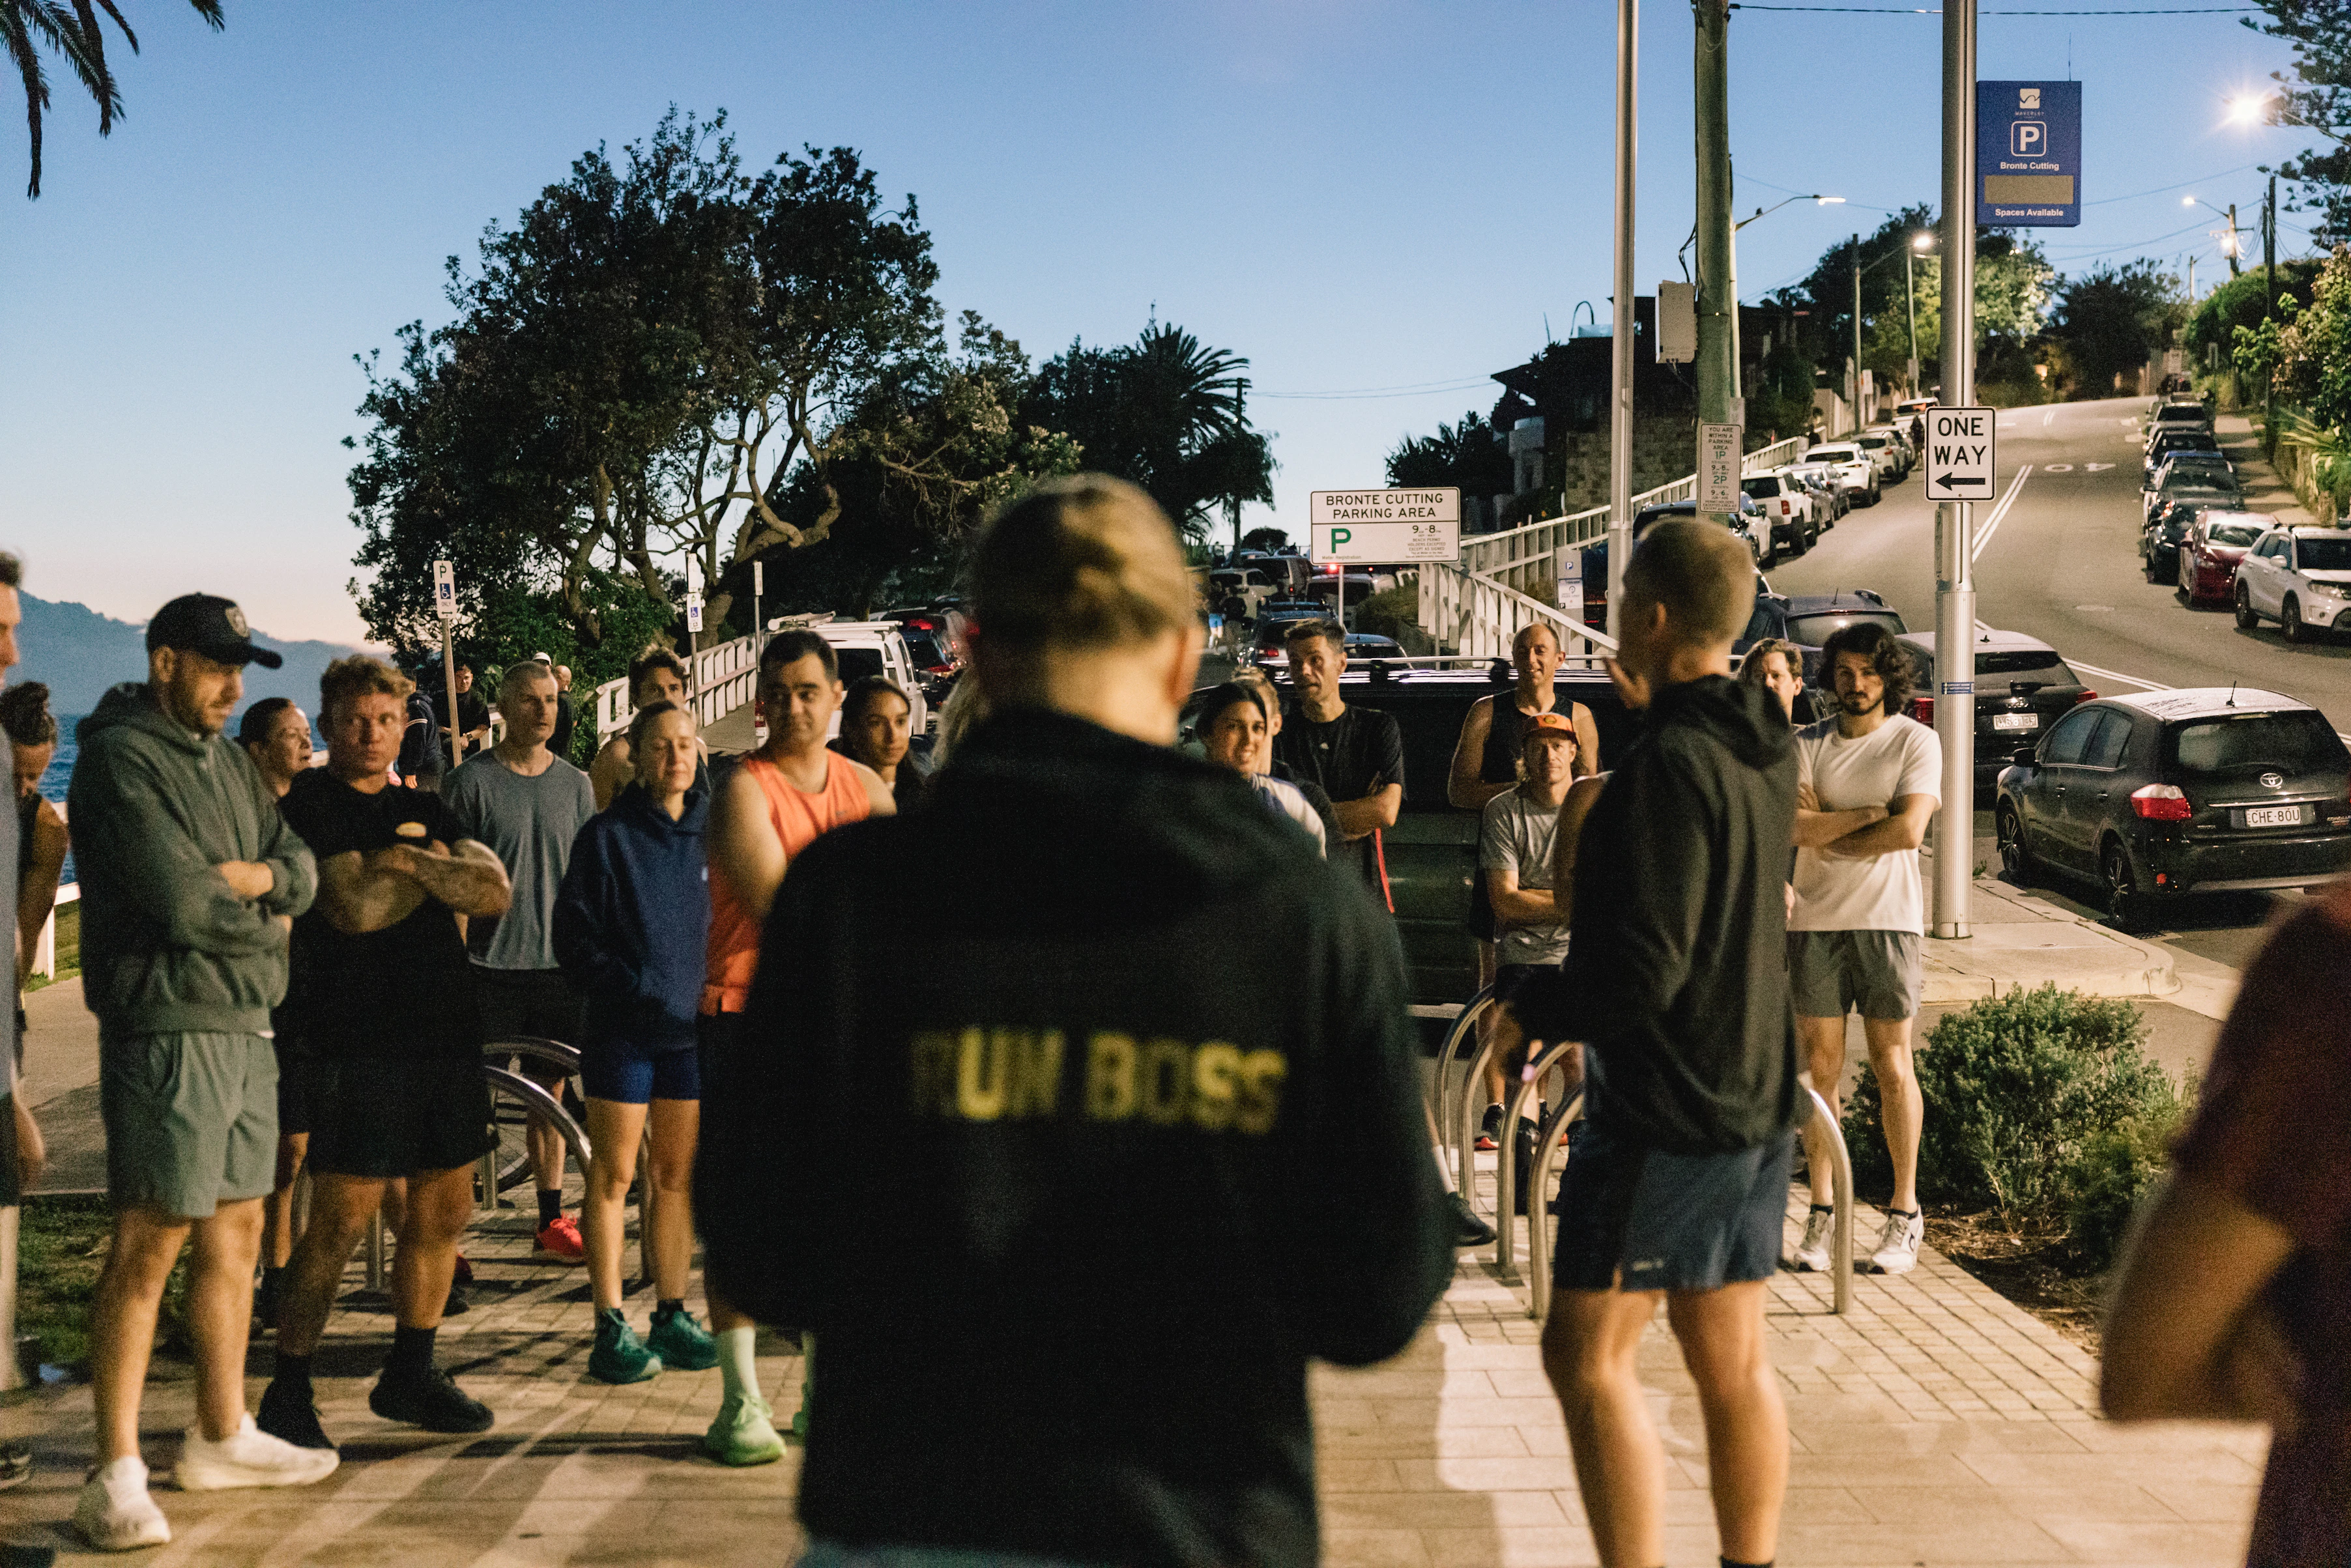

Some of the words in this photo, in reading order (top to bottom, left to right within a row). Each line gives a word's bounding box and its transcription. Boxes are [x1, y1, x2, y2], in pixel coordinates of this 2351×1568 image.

[2020, 126, 2040, 151] P
[2030, 162, 2059, 171] Cutting
[1938, 418, 1983, 436] ONE
[1934, 446, 1987, 464] WAY
[1713, 475, 1727, 484] 2P
[1326, 494, 1380, 506] BRONTE
[1386, 493, 1443, 504] CUTTING
[1333, 508, 1392, 519] PARKING
[1398, 507, 1436, 518] AREA
[1331, 528, 1351, 554] P
[440, 565, 446, 578] P
[1086, 1031, 1288, 1133] BOSS
